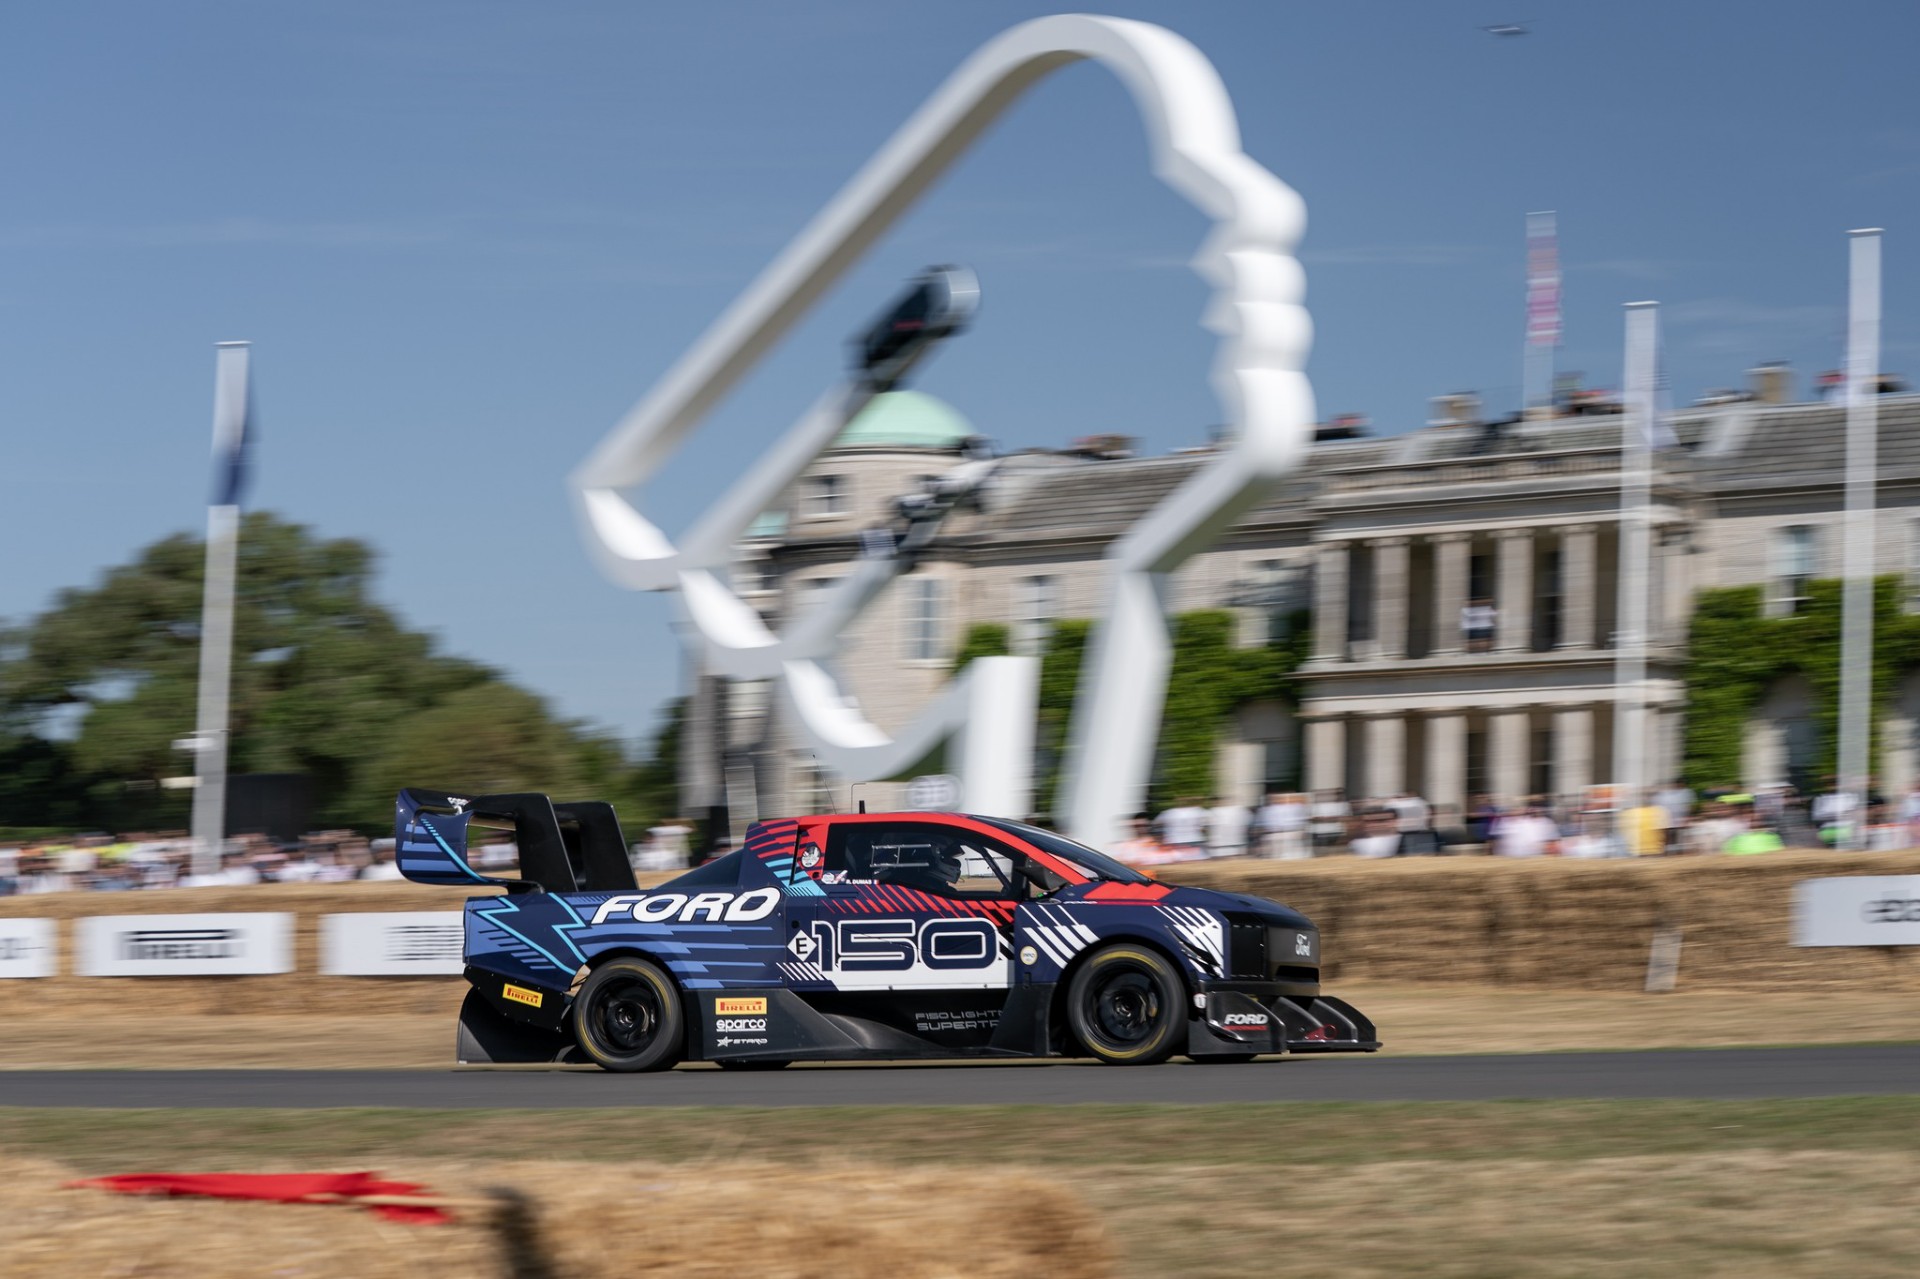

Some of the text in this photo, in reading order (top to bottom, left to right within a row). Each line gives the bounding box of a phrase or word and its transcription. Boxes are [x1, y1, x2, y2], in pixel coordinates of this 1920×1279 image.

[591, 887, 781, 924] FORD
[796, 937, 808, 955] E
[812, 918, 1000, 973] 150
[507, 987, 539, 1004] PIRELLI
[720, 1001, 762, 1011] PIRELLI
[716, 1019, 767, 1032] sparco
[1224, 1013, 1268, 1025] FORD
